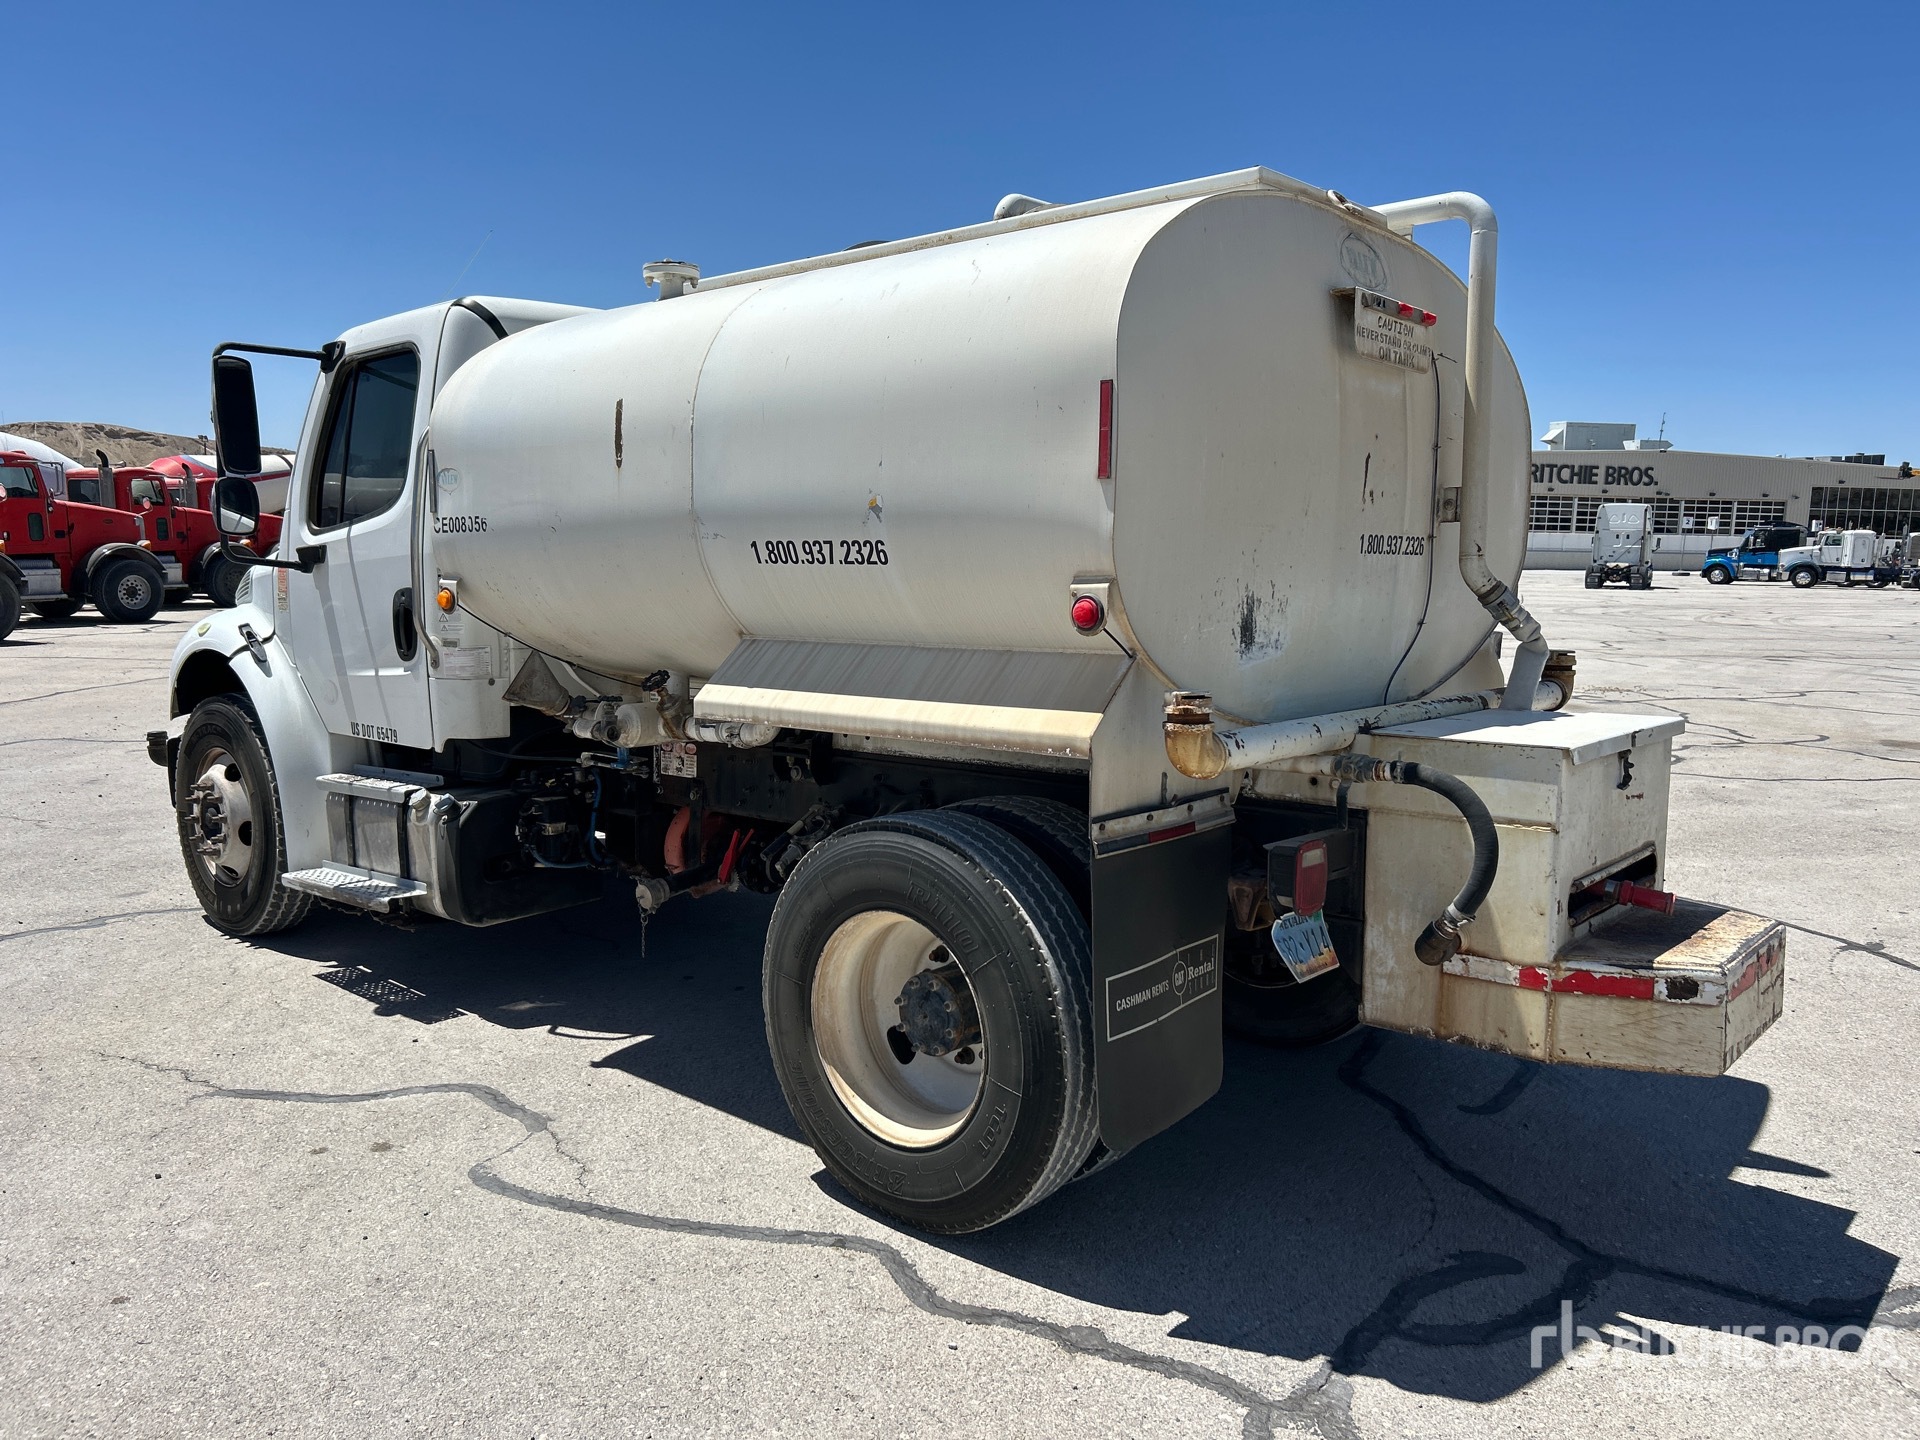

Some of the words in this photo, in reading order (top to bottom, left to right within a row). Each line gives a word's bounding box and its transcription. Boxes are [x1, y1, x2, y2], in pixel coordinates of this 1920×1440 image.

[1356, 324, 1380, 343] NEVER
[1380, 332, 1402, 349] STAND
[1377, 315, 1415, 338] CAUTION
[1392, 349, 1415, 369] TANK
[1531, 463, 1599, 485] RITCHIE
[1604, 465, 1659, 487] BROS.
[750, 539, 889, 566] 1.800.937.2326
[1359, 533, 1425, 556] 1.800.937.2326
[350, 721, 360, 737] US
[361, 723, 375, 740] DOT
[376, 726, 398, 743] 65479
[1115, 988, 1152, 1012] CASHMAN
[1152, 979, 1170, 998] RENTS
[1174, 970, 1185, 987] CAT
[1187, 957, 1215, 980] Rental
